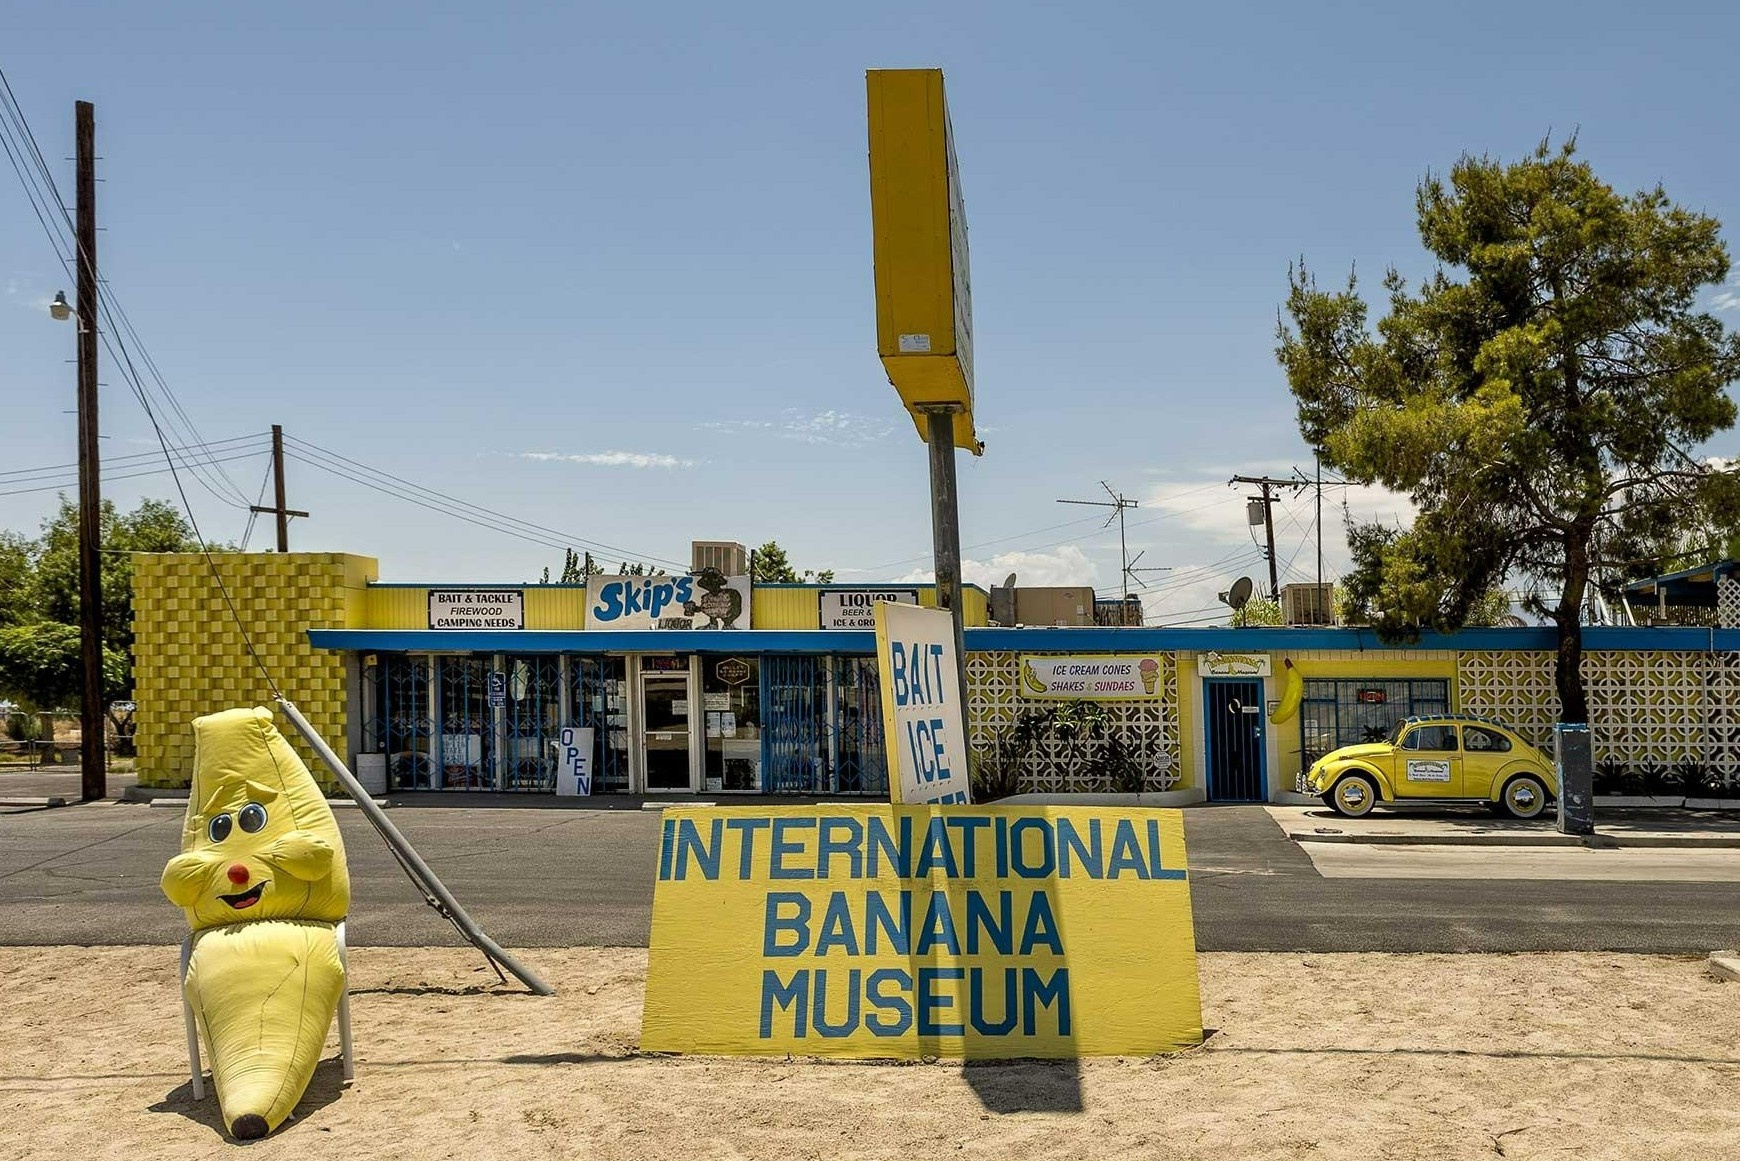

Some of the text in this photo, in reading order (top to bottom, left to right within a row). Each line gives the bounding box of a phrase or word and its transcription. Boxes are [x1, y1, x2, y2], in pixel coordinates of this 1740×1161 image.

[438, 594, 513, 604] BAIT & TACKLE
[450, 607, 503, 616] FIREWOOD
[593, 576, 693, 622] Skip's
[842, 608, 872, 616] BEER &
[437, 618, 515, 628] CAMPING NEEDS
[833, 618, 847, 627] ICE
[848, 618, 856, 627] &
[891, 641, 944, 707] BAIT
[1052, 664, 1132, 676] ICE CREAM CONES
[1051, 681, 1085, 692] SHAKES
[1094, 681, 1135, 692] SUNDAES
[561, 728, 590, 795] OPEN
[907, 718, 951, 785] ICE
[658, 816, 1188, 881] INTERNATIONAL
[762, 890, 1065, 958] BANANA
[759, 967, 1072, 1039] MUSEUM
